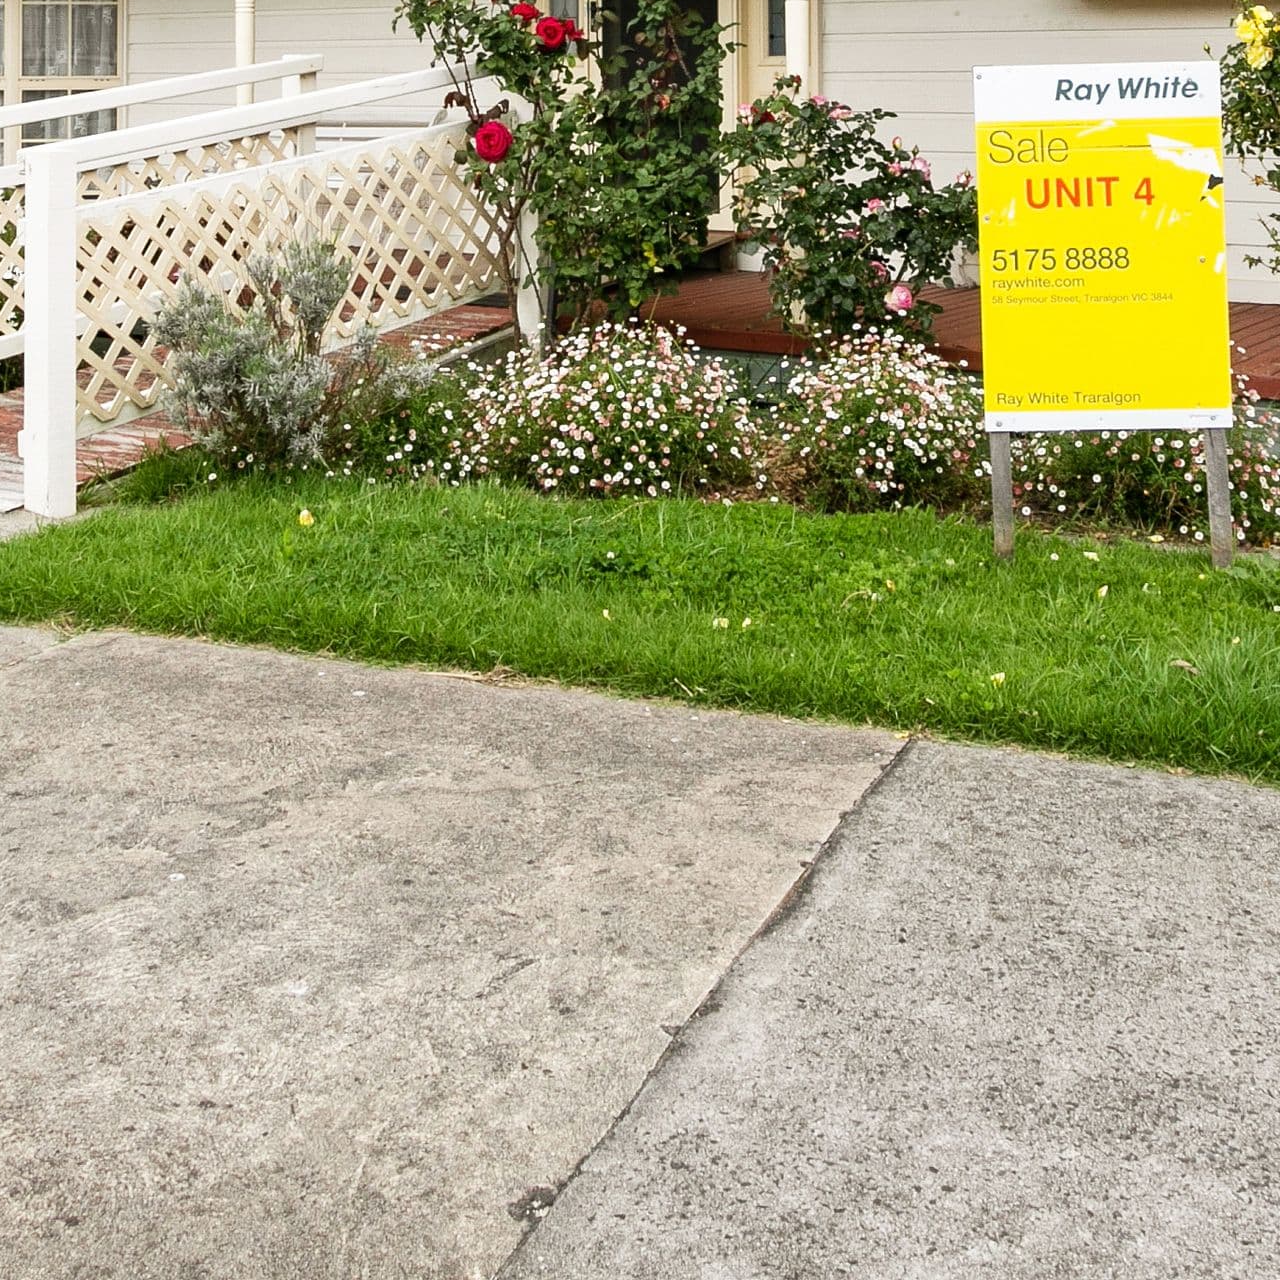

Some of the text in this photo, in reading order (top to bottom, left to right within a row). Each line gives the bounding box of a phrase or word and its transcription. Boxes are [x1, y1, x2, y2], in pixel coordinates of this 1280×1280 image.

[1054, 76, 1199, 106] Ray White
[988, 130, 1070, 164] Sale
[1025, 176, 1156, 209] UNIT 4
[991, 246, 1131, 272] 5175 8888
[991, 276, 1086, 292] raywhite.com
[1005, 295, 1048, 306] Seymour
[1084, 293, 1130, 304] Traralgon
[1130, 292, 1148, 302] VIC
[1150, 292, 1174, 302] 3844
[996, 390, 1142, 408] Ray White Traralgon
